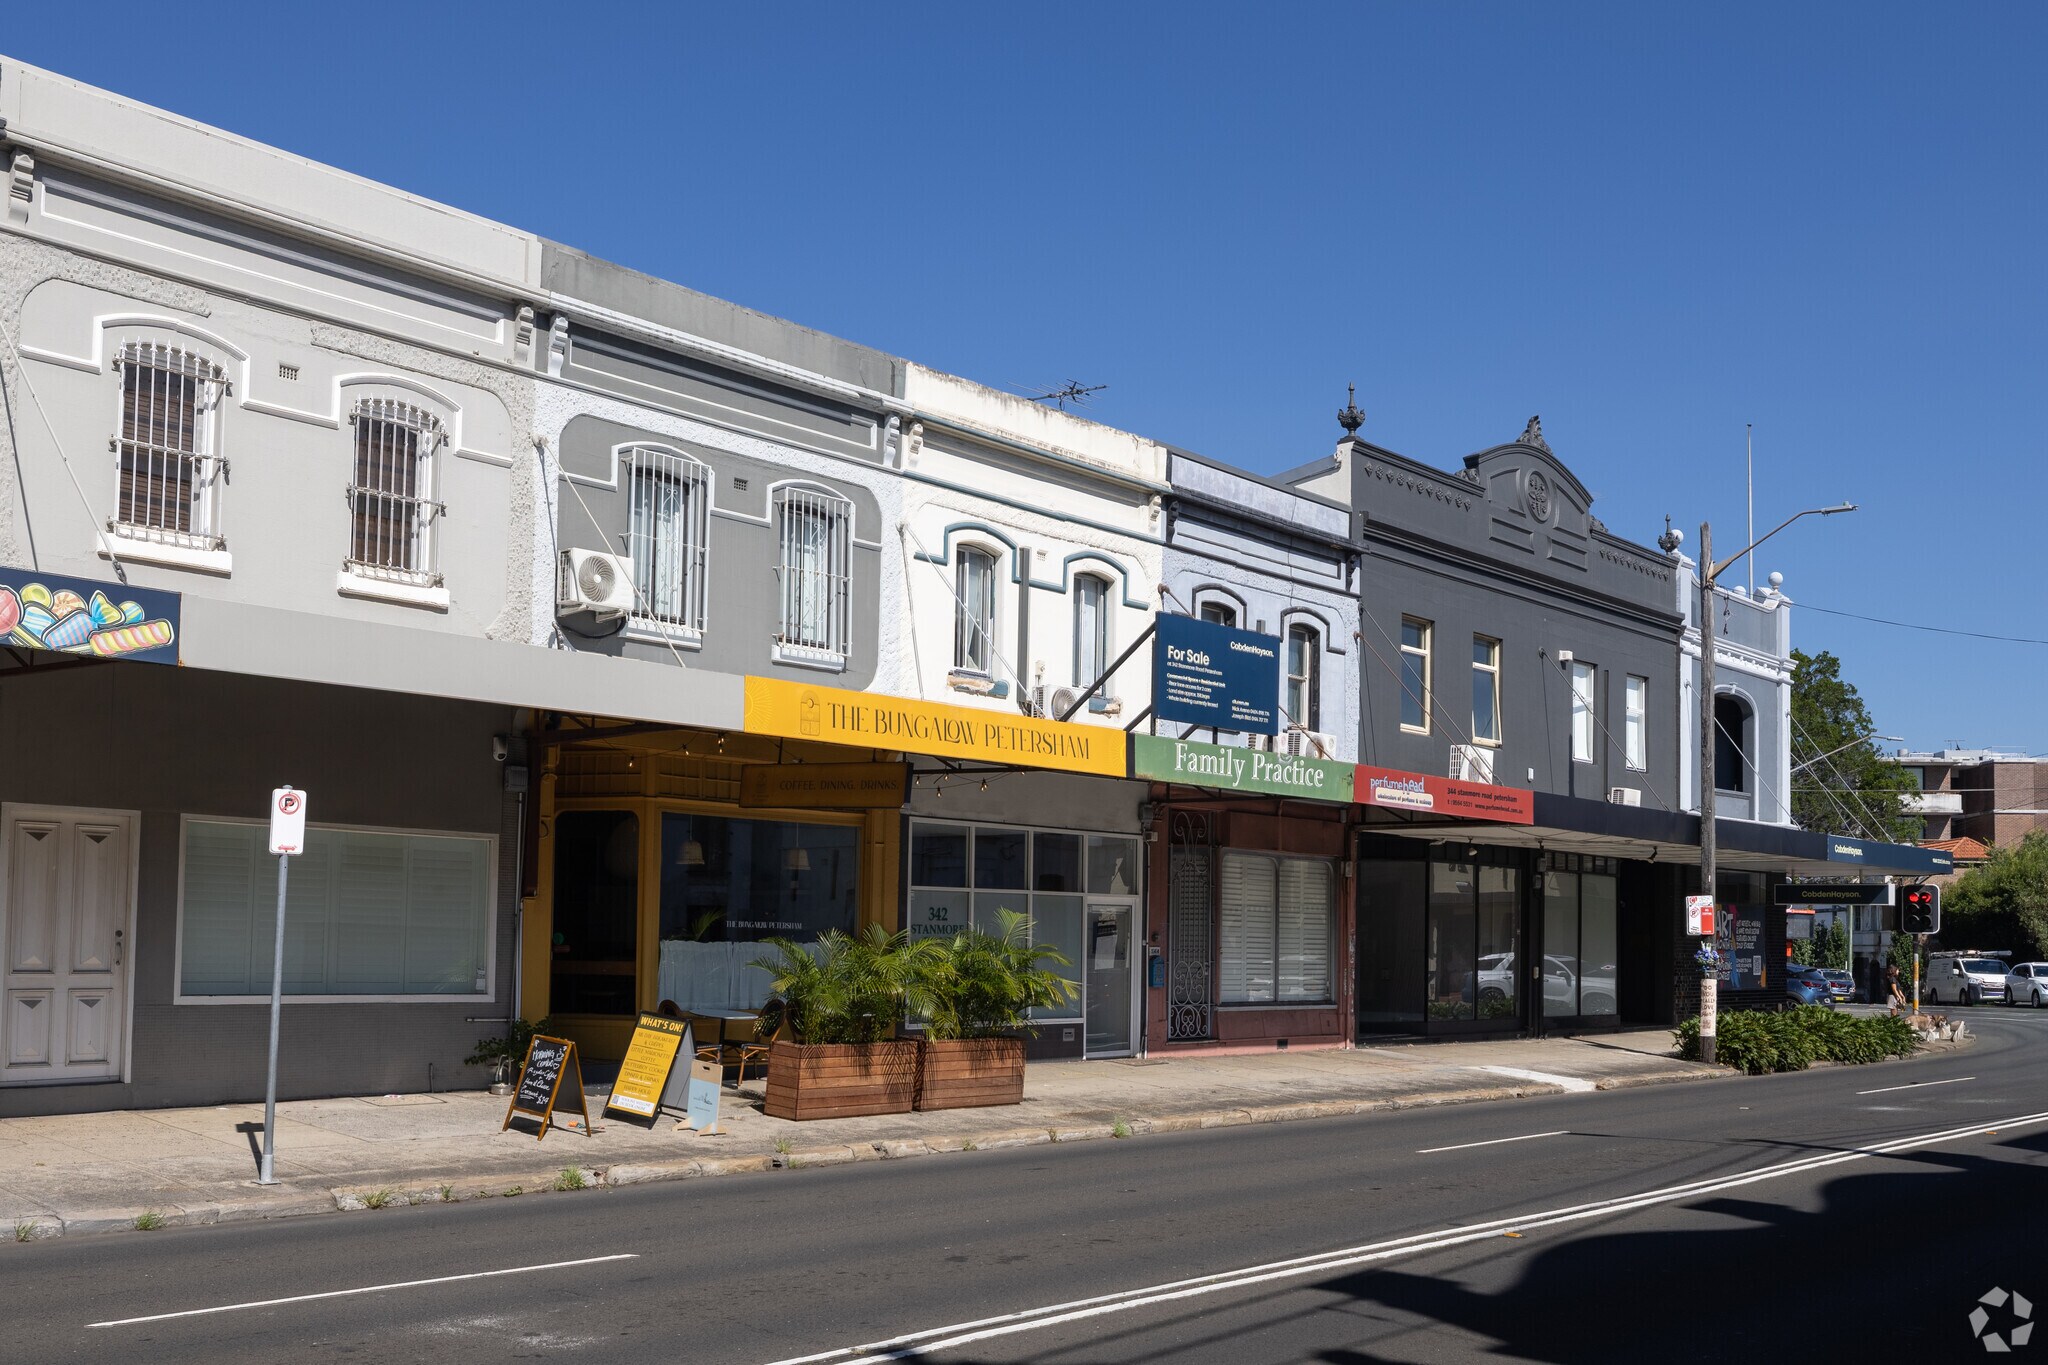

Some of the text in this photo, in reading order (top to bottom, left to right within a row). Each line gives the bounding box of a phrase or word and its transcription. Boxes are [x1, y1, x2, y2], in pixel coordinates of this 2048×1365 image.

[1168, 645, 1210, 666] For Sale
[1230, 641, 1274, 657] CobdenHayson.
[828, 702, 1090, 760] THE BUNGALOW PETERSHAM
[1174, 742, 1324, 788] Family Practice
[780, 780, 899, 791] COFFEE. DINING. DRINKS.
[1370, 776, 1424, 793] perfumehead
[1802, 890, 1862, 900] CobdenHayson.
[928, 906, 948, 921] 342
[640, 1016, 684, 1032] WHAT'S ON!
